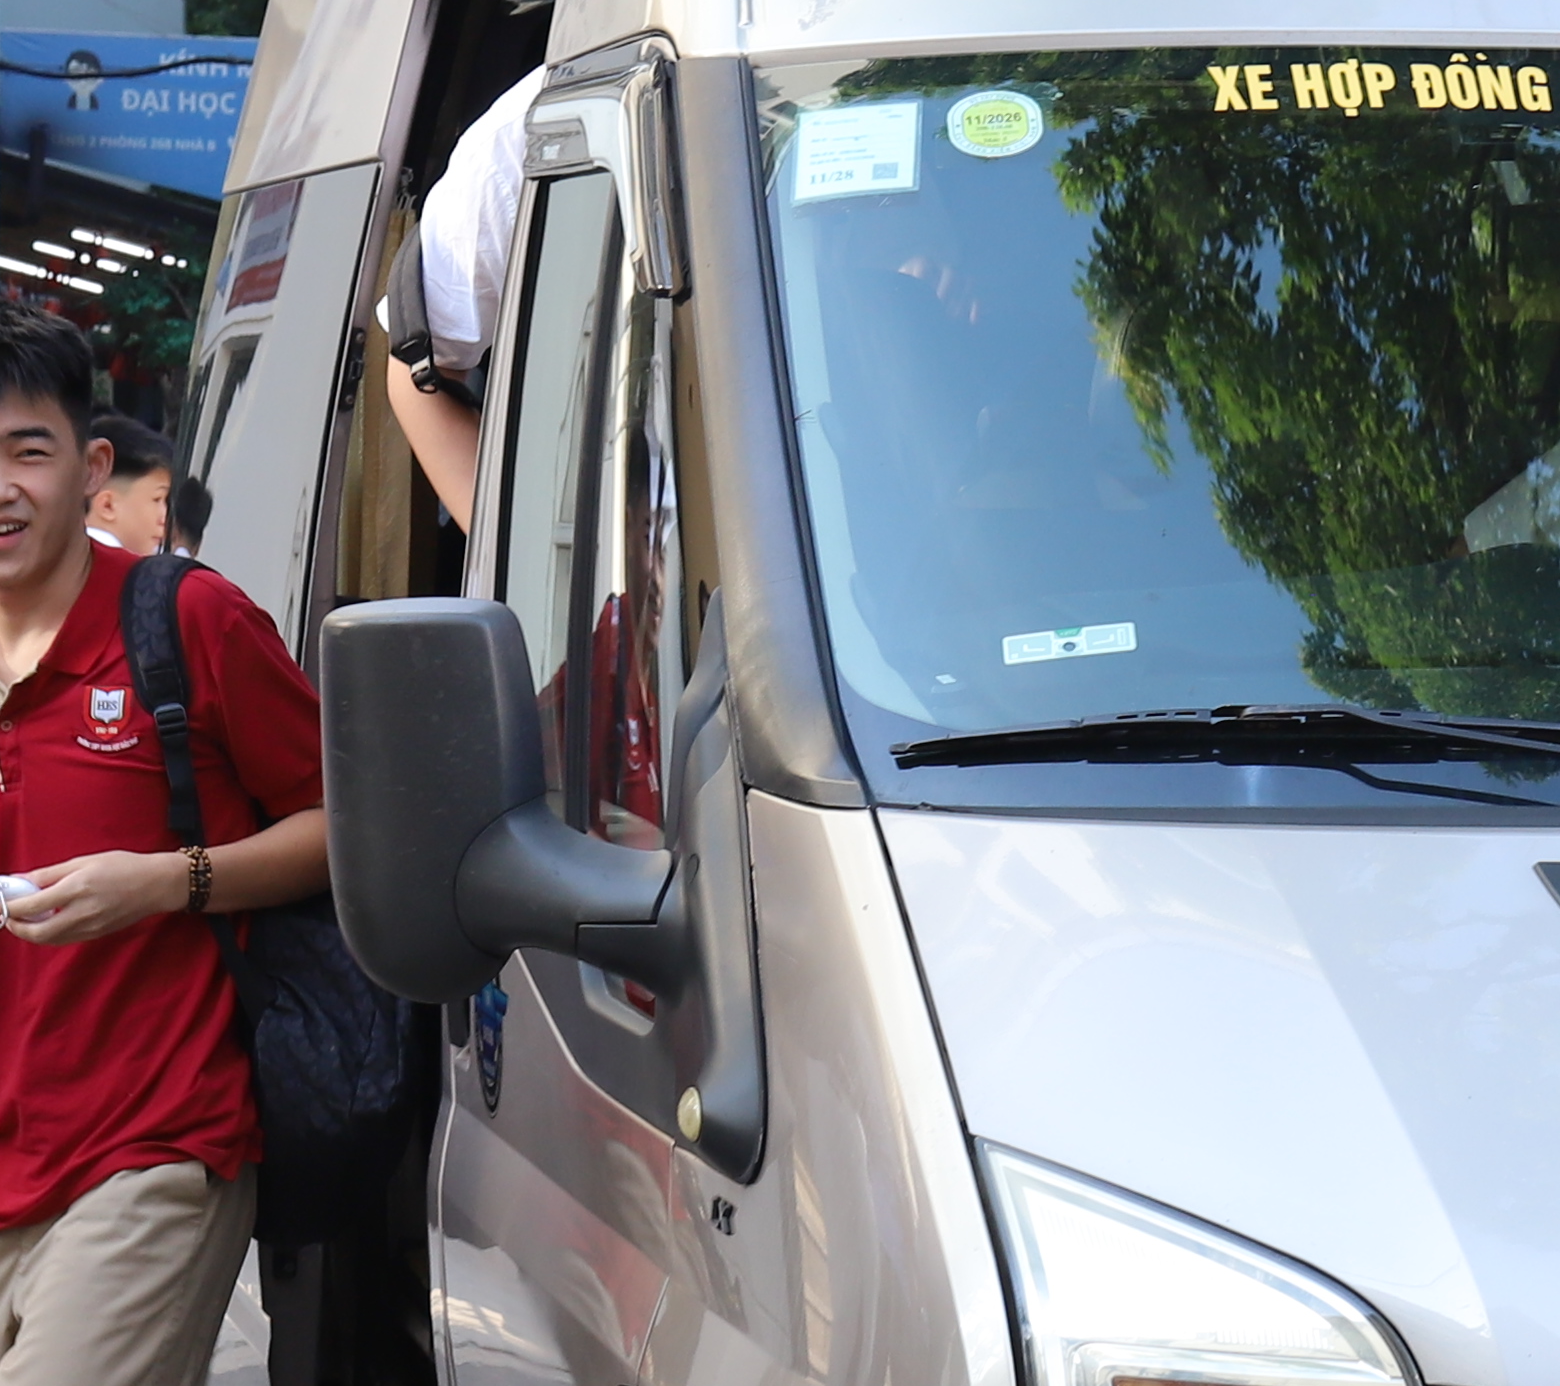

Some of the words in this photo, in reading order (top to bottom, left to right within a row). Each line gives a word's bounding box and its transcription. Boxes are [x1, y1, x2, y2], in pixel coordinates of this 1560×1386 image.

[1206, 64, 1280, 112] XE
[1290, 58, 1397, 117] HỢP
[1409, 52, 1554, 113] ĐỒNG
[120, 87, 171, 117] ĐẠI
[177, 91, 237, 120] HỌC
[964, 111, 1023, 126] 11/2026
[809, 169, 855, 185] 11/28
